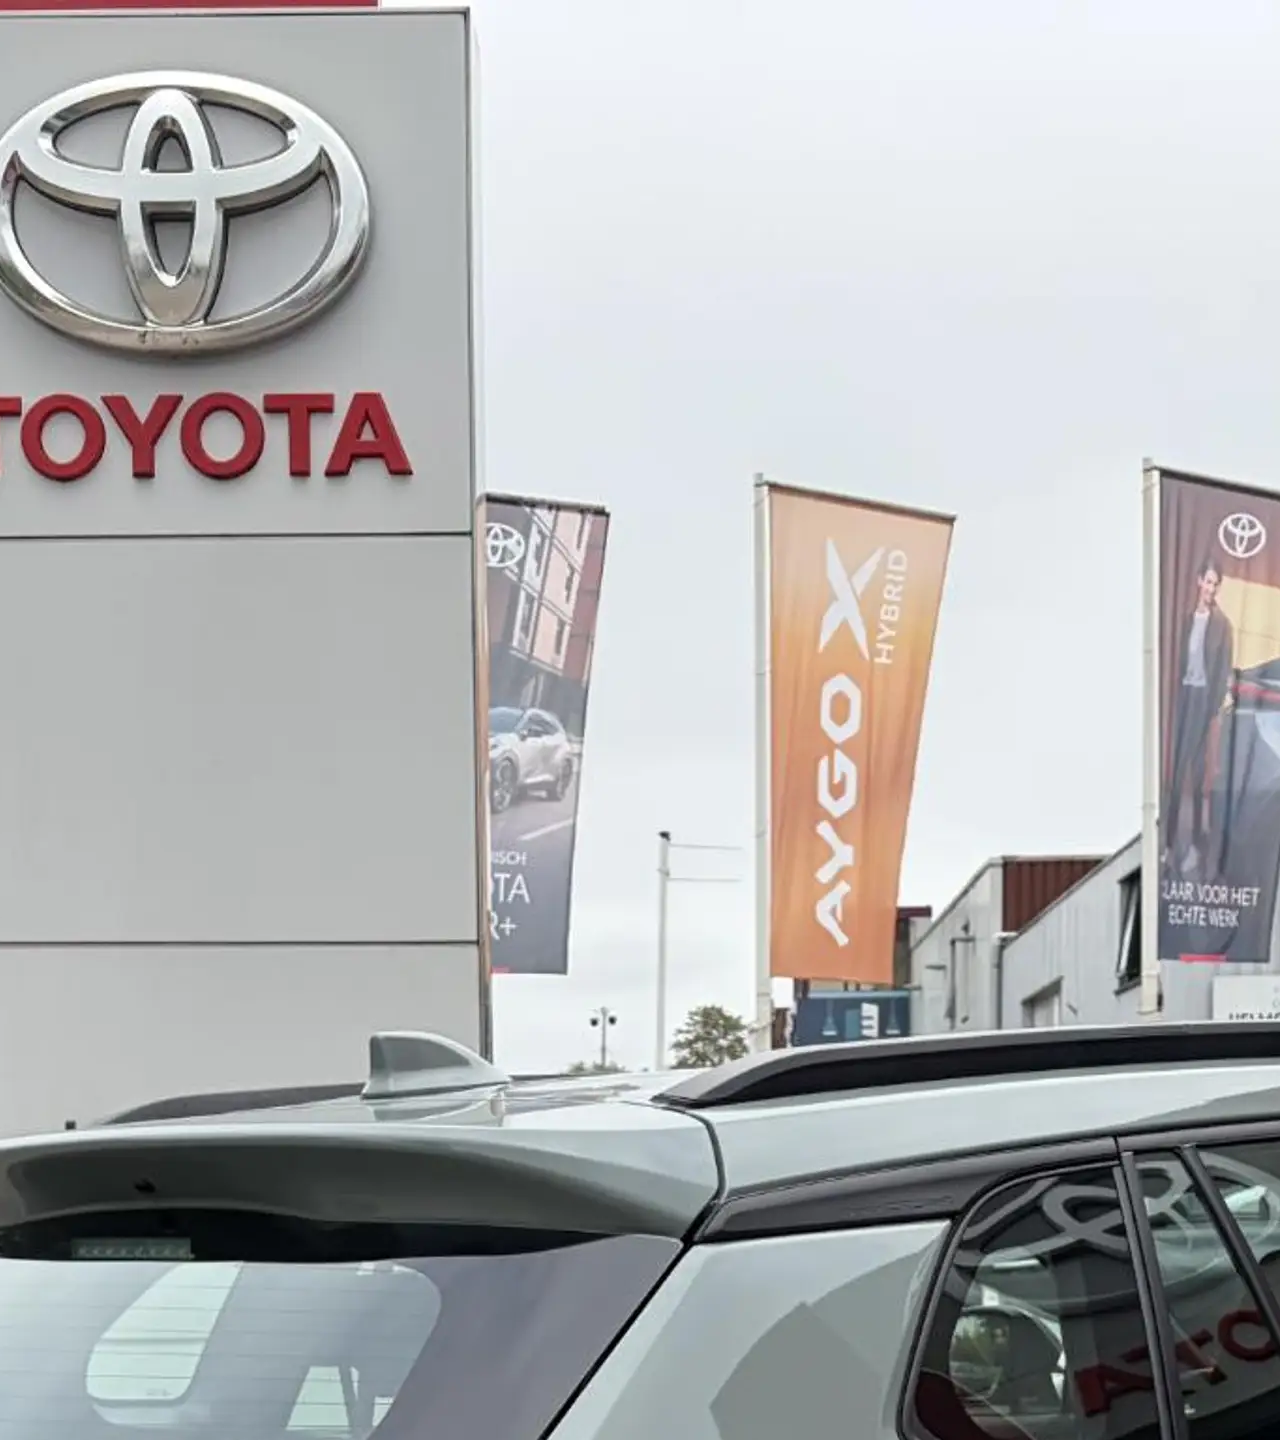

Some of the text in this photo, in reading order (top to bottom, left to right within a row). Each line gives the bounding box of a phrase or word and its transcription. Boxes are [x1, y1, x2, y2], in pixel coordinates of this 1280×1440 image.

[874, 548, 908, 665] HYBRID
[815, 536, 885, 948] AYGO X
[1168, 903, 1208, 926] ECHTE
[1196, 884, 1229, 905] VOOR
[1231, 887, 1261, 906] HET
